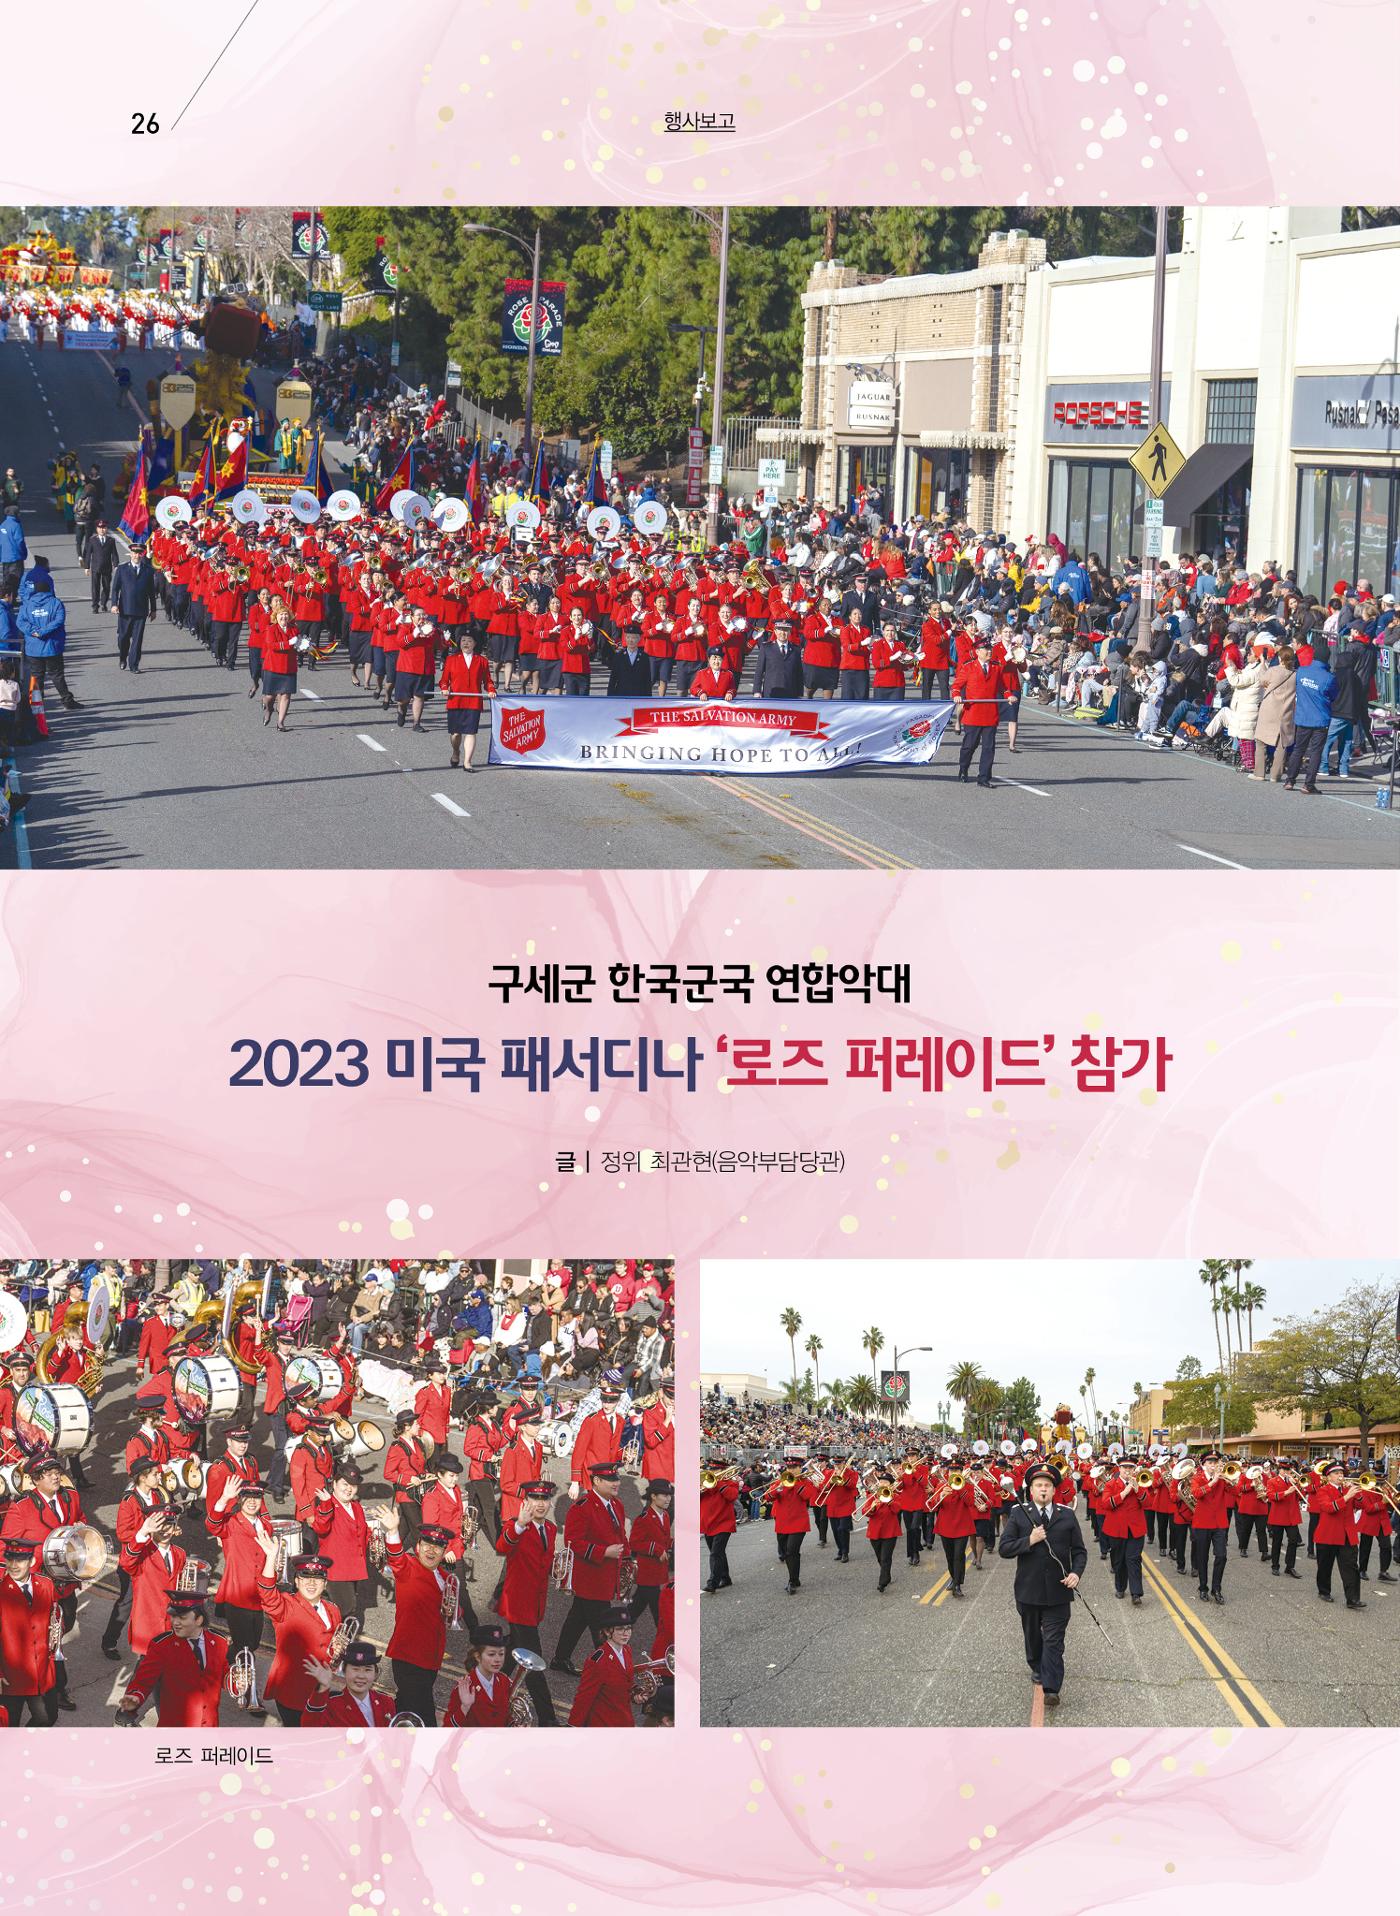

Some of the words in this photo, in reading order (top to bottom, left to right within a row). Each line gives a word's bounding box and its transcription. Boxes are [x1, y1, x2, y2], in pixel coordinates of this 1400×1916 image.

[507, 296, 529, 316] ROSE
[539, 296, 563, 328] PARADE
[857, 393, 891, 401] JAGUAR
[856, 413, 891, 421] RUSNAK
[1054, 401, 1145, 425] PORSCHE
[1325, 400, 1361, 424] Rusnak
[508, 711, 526, 727] THE
[650, 711, 680, 723] THE
[683, 709, 757, 723] SALVATION
[759, 713, 798, 726] ARMY
[503, 714, 541, 743] SALVATION
[515, 727, 540, 750] ARMY
[581, 745, 701, 761] BRINGING
[711, 748, 772, 763] HOPE
[779, 748, 809, 762] TO
